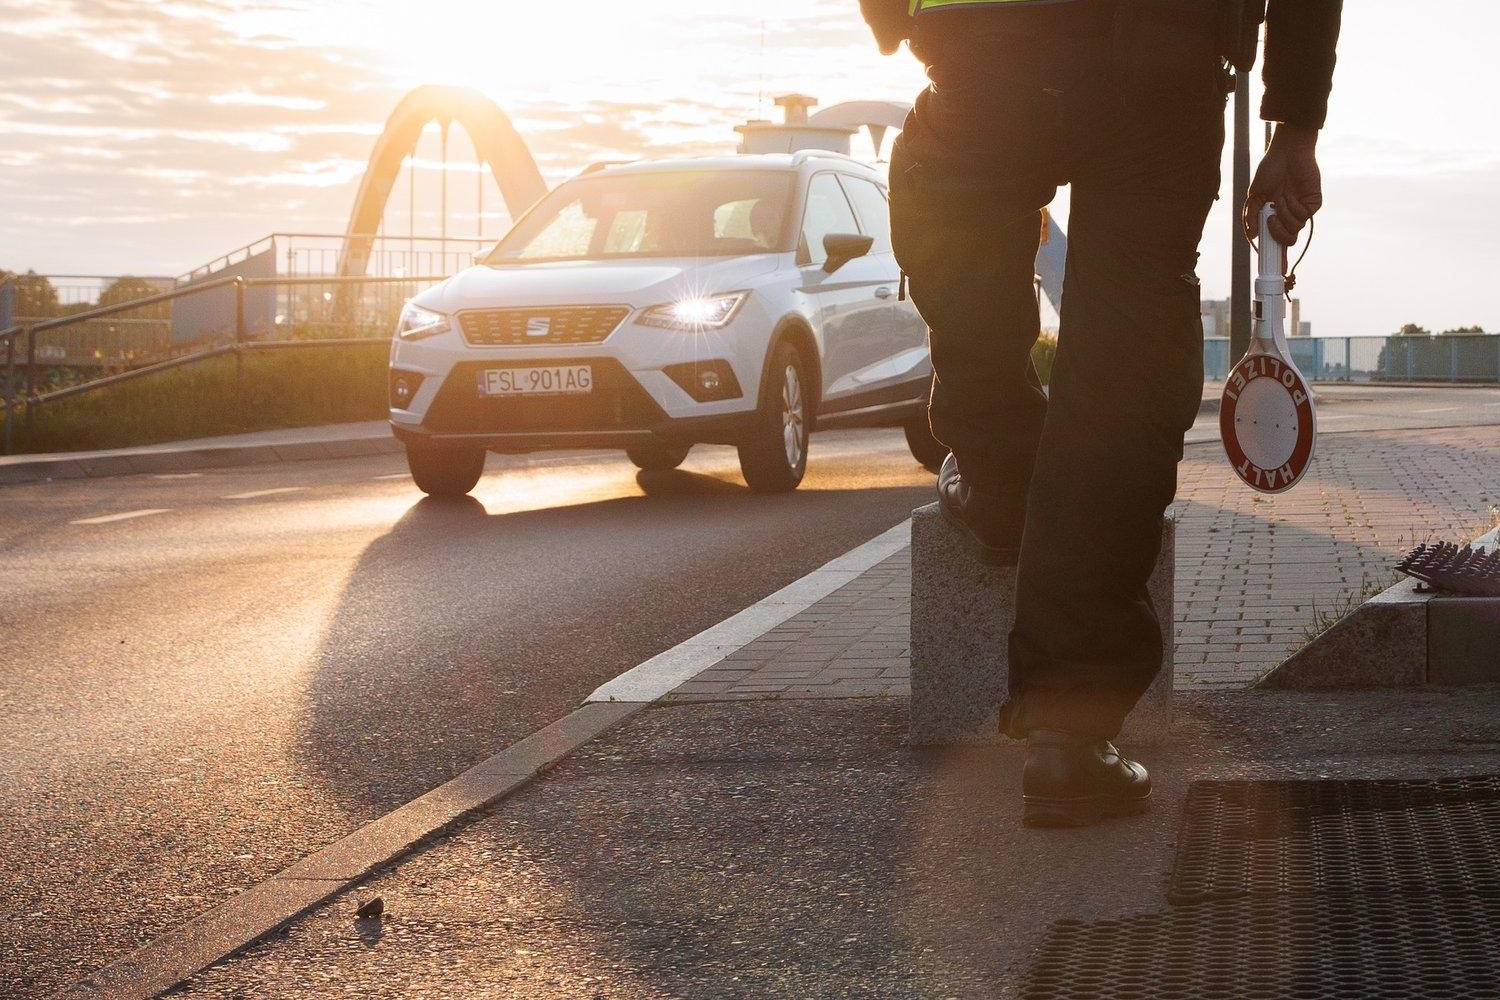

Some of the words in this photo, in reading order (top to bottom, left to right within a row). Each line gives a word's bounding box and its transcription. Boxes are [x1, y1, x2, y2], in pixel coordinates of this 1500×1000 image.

[486, 371, 523, 392] FSL
[529, 367, 590, 390] 901AG
[1226, 357, 1308, 406] POLIZEI
[1236, 459, 1295, 488] HALT
